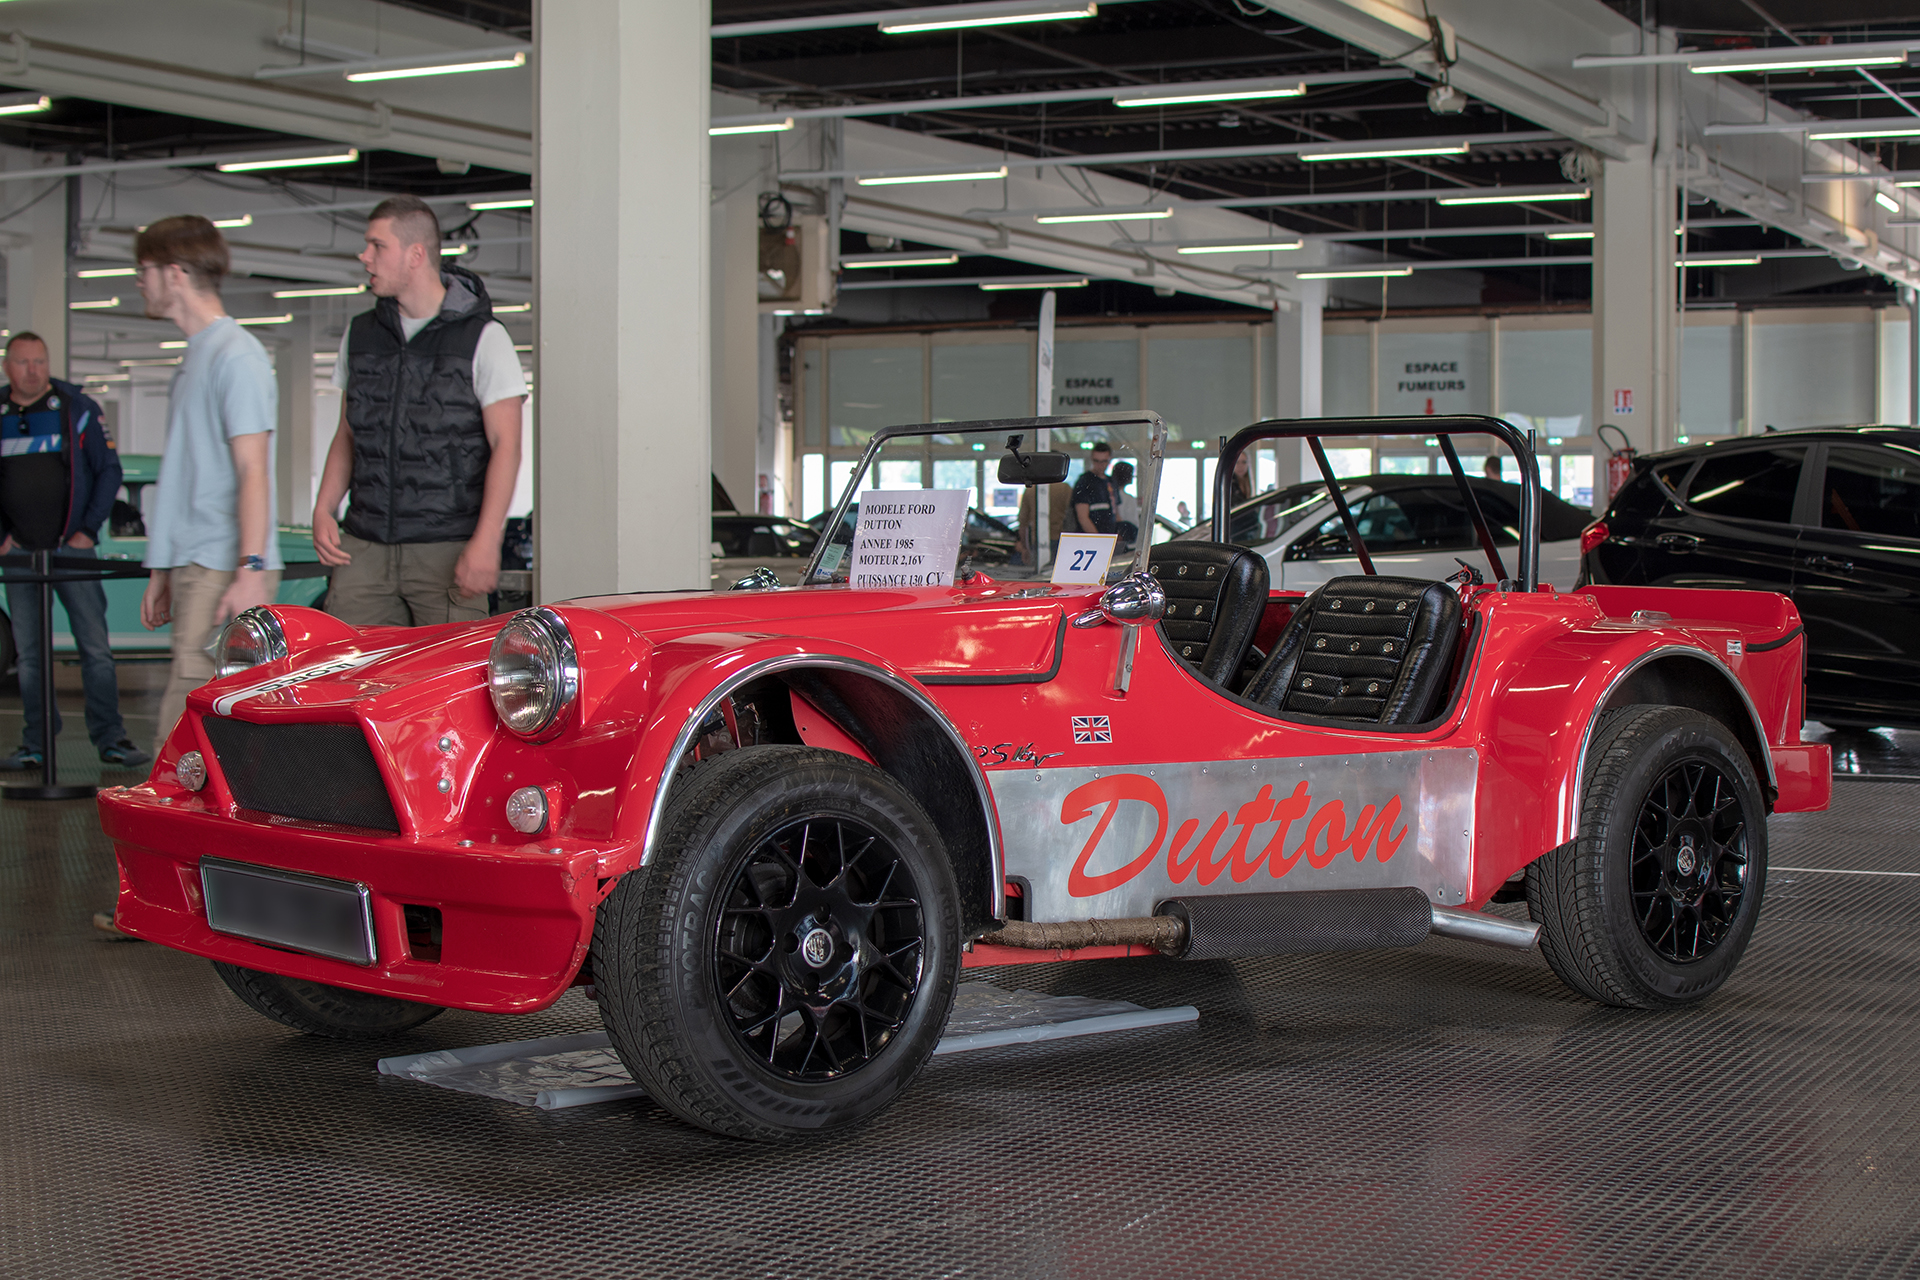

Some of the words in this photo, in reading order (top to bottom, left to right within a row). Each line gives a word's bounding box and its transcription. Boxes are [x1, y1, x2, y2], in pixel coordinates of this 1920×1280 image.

[1405, 362, 1458, 374] ESPACE
[1065, 378, 1113, 389] ESPACE
[1398, 381, 1465, 392] FUMEURS
[1059, 395, 1120, 406] FUMEURS
[865, 504, 906, 515] MODELE
[907, 504, 936, 515] FORD
[863, 519, 903, 530] DUTTON
[860, 539, 892, 549] ANNEE
[894, 539, 914, 549] 1985
[859, 555, 899, 566] MOTEUR
[1069, 549, 1098, 571] 27
[857, 574, 907, 586] PUISSANCE
[926, 571, 944, 587] CV
[255, 662, 356, 692] FORD
[1060, 773, 1409, 898] Dutton
